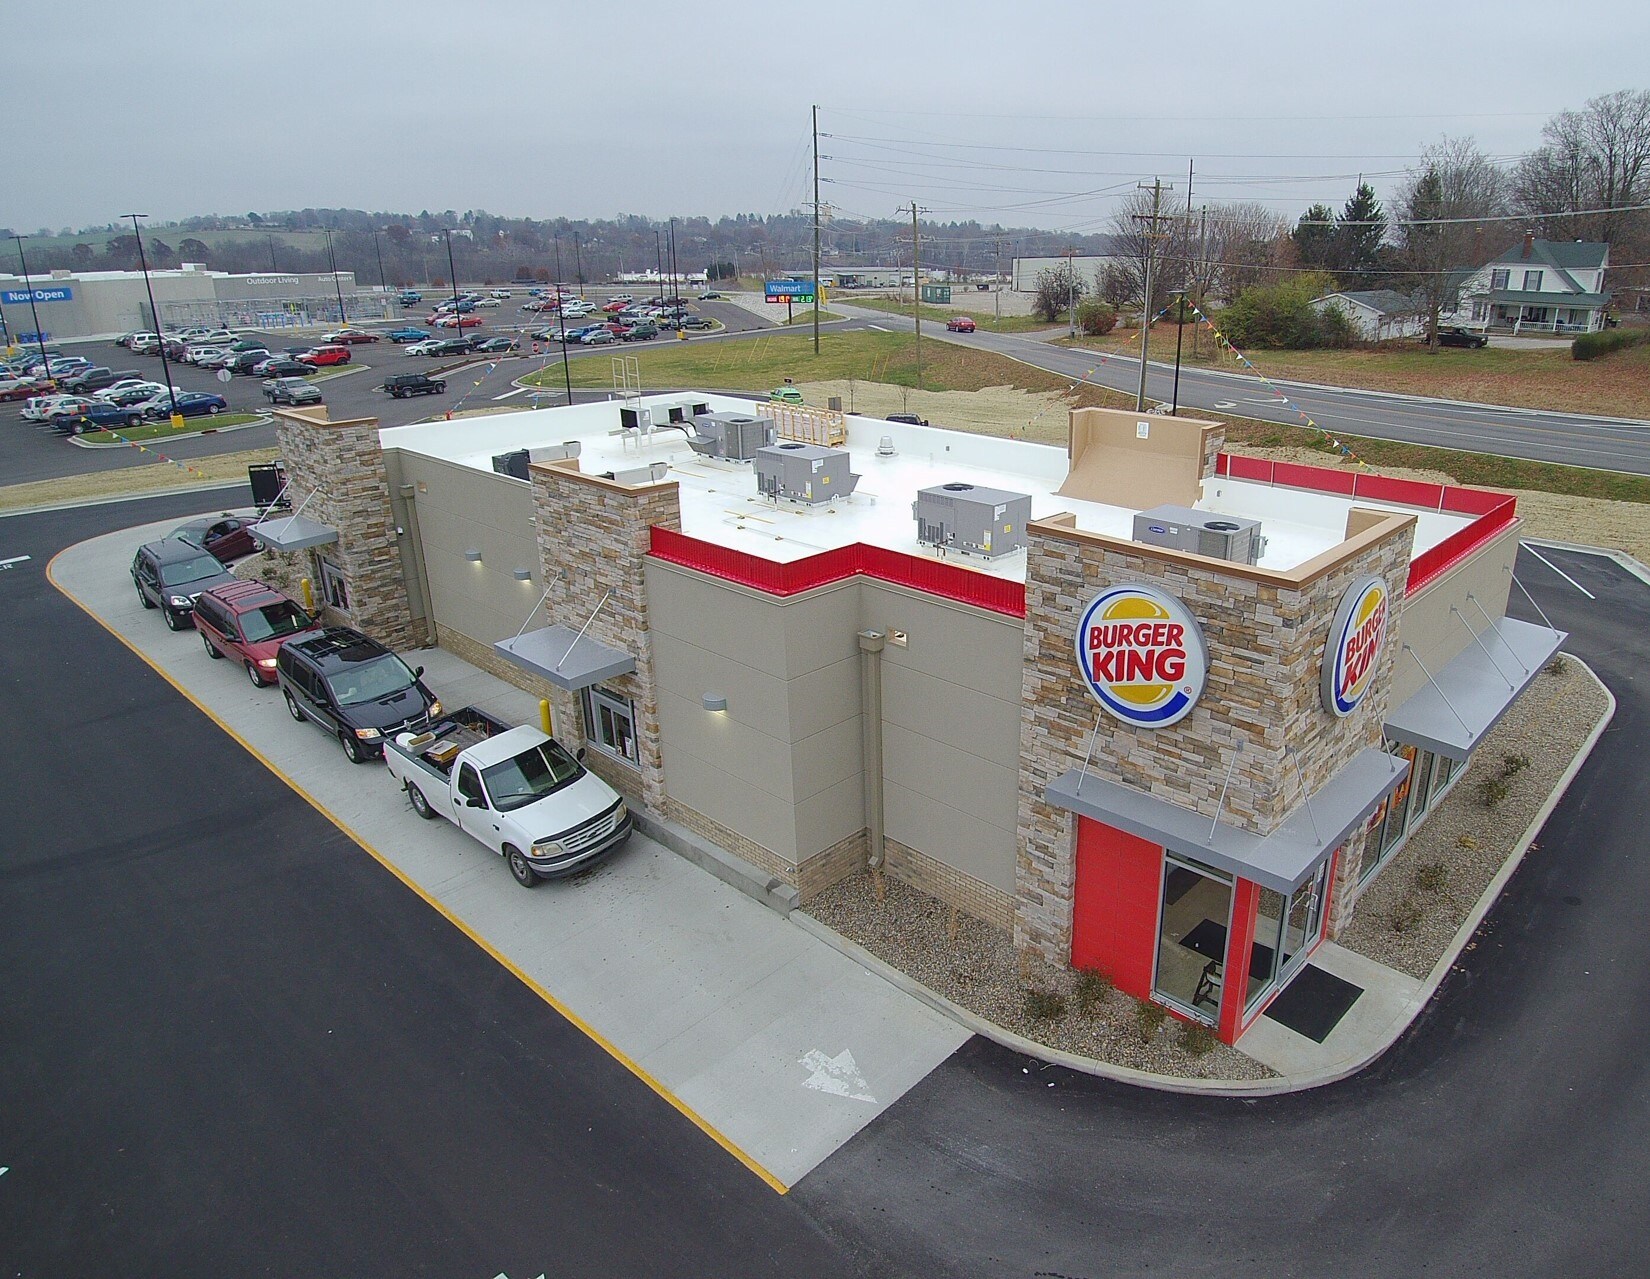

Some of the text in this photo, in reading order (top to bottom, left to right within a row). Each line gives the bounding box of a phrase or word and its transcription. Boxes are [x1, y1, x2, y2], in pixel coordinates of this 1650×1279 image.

[247, 277, 276, 285] Outdoor
[769, 285, 801, 293] Walmart
[35, 290, 65, 301] Open
[1089, 623, 1184, 650] BURGER
[1092, 648, 1187, 683] KING
